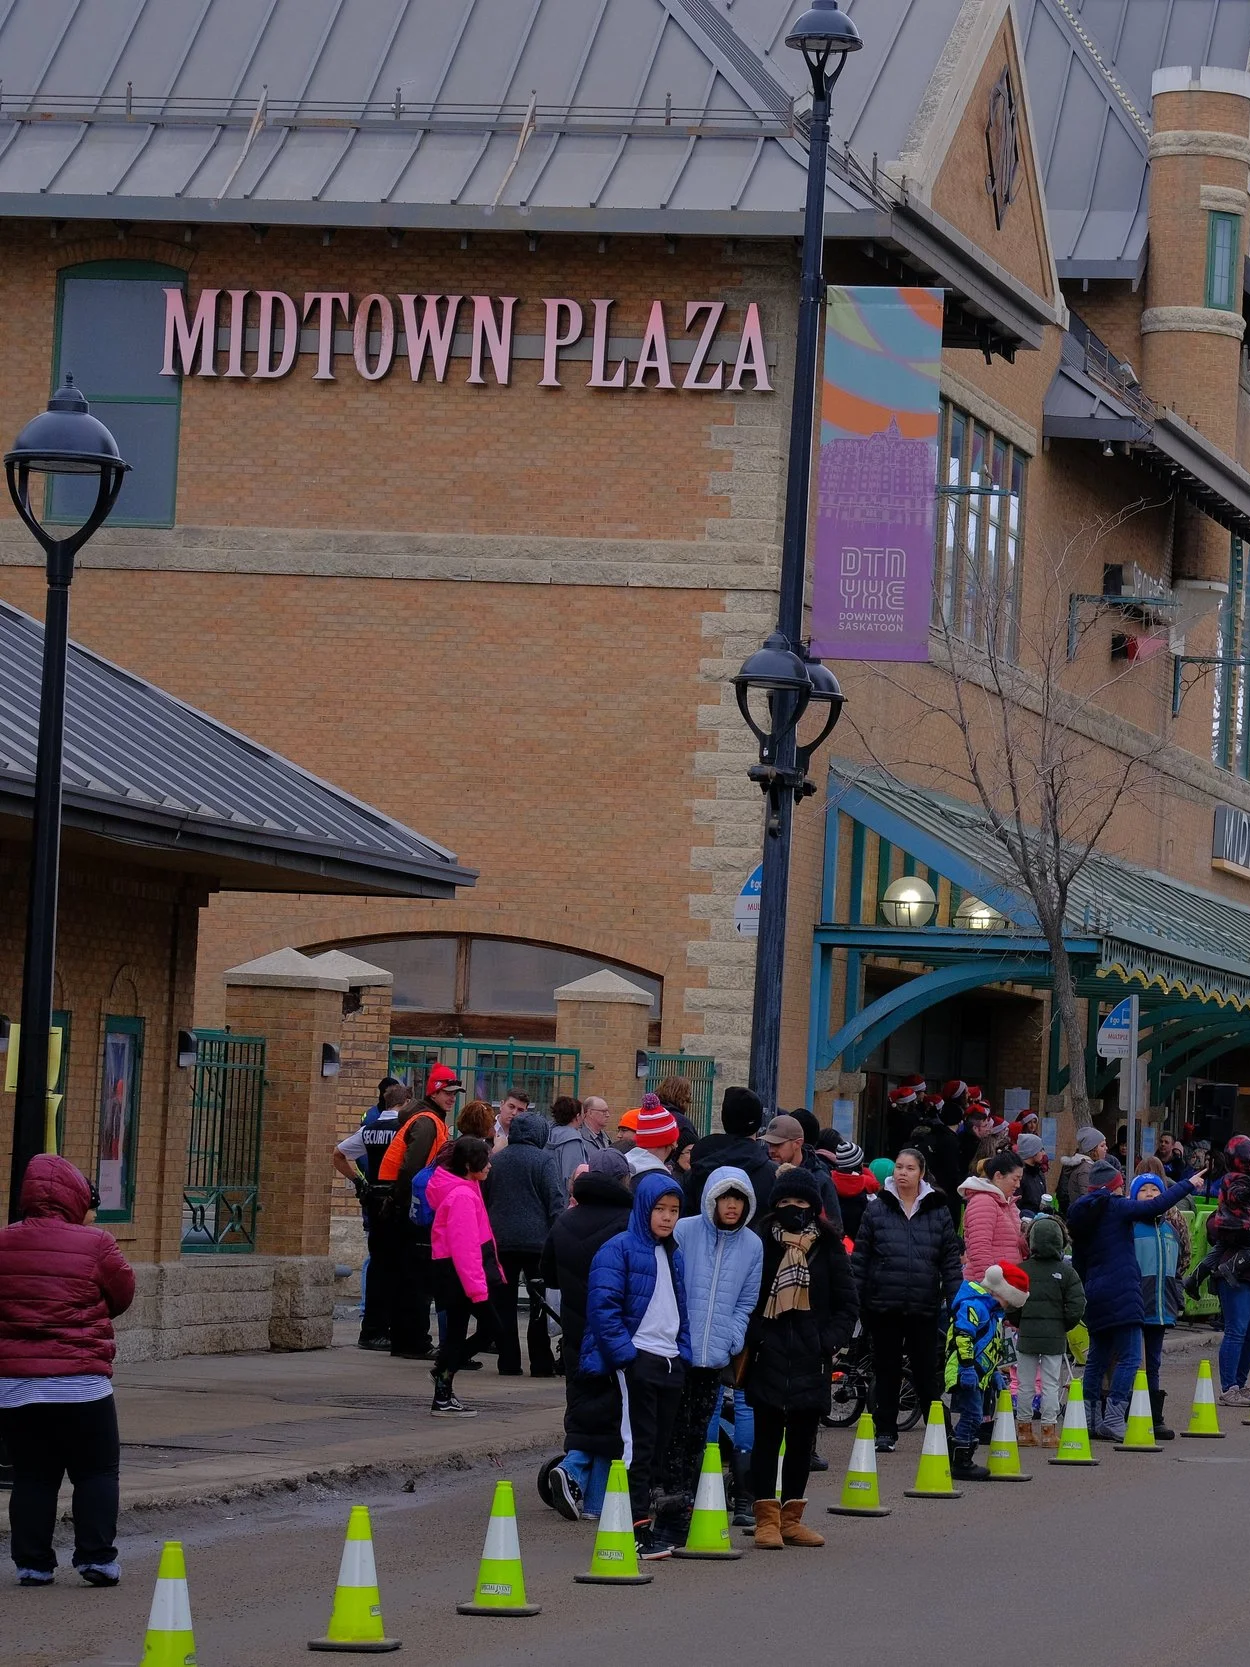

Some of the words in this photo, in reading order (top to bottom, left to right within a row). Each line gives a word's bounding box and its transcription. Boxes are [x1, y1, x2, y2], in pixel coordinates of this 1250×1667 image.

[158, 287, 519, 386] MIDTOWN
[537, 298, 775, 391] PLAZA
[841, 546, 906, 578] DTN
[840, 579, 905, 610] YXE
[838, 622, 904, 632] SASKATOON
[839, 612, 904, 623] DOWNTOWN
[363, 1129, 397, 1145] SECURITY
